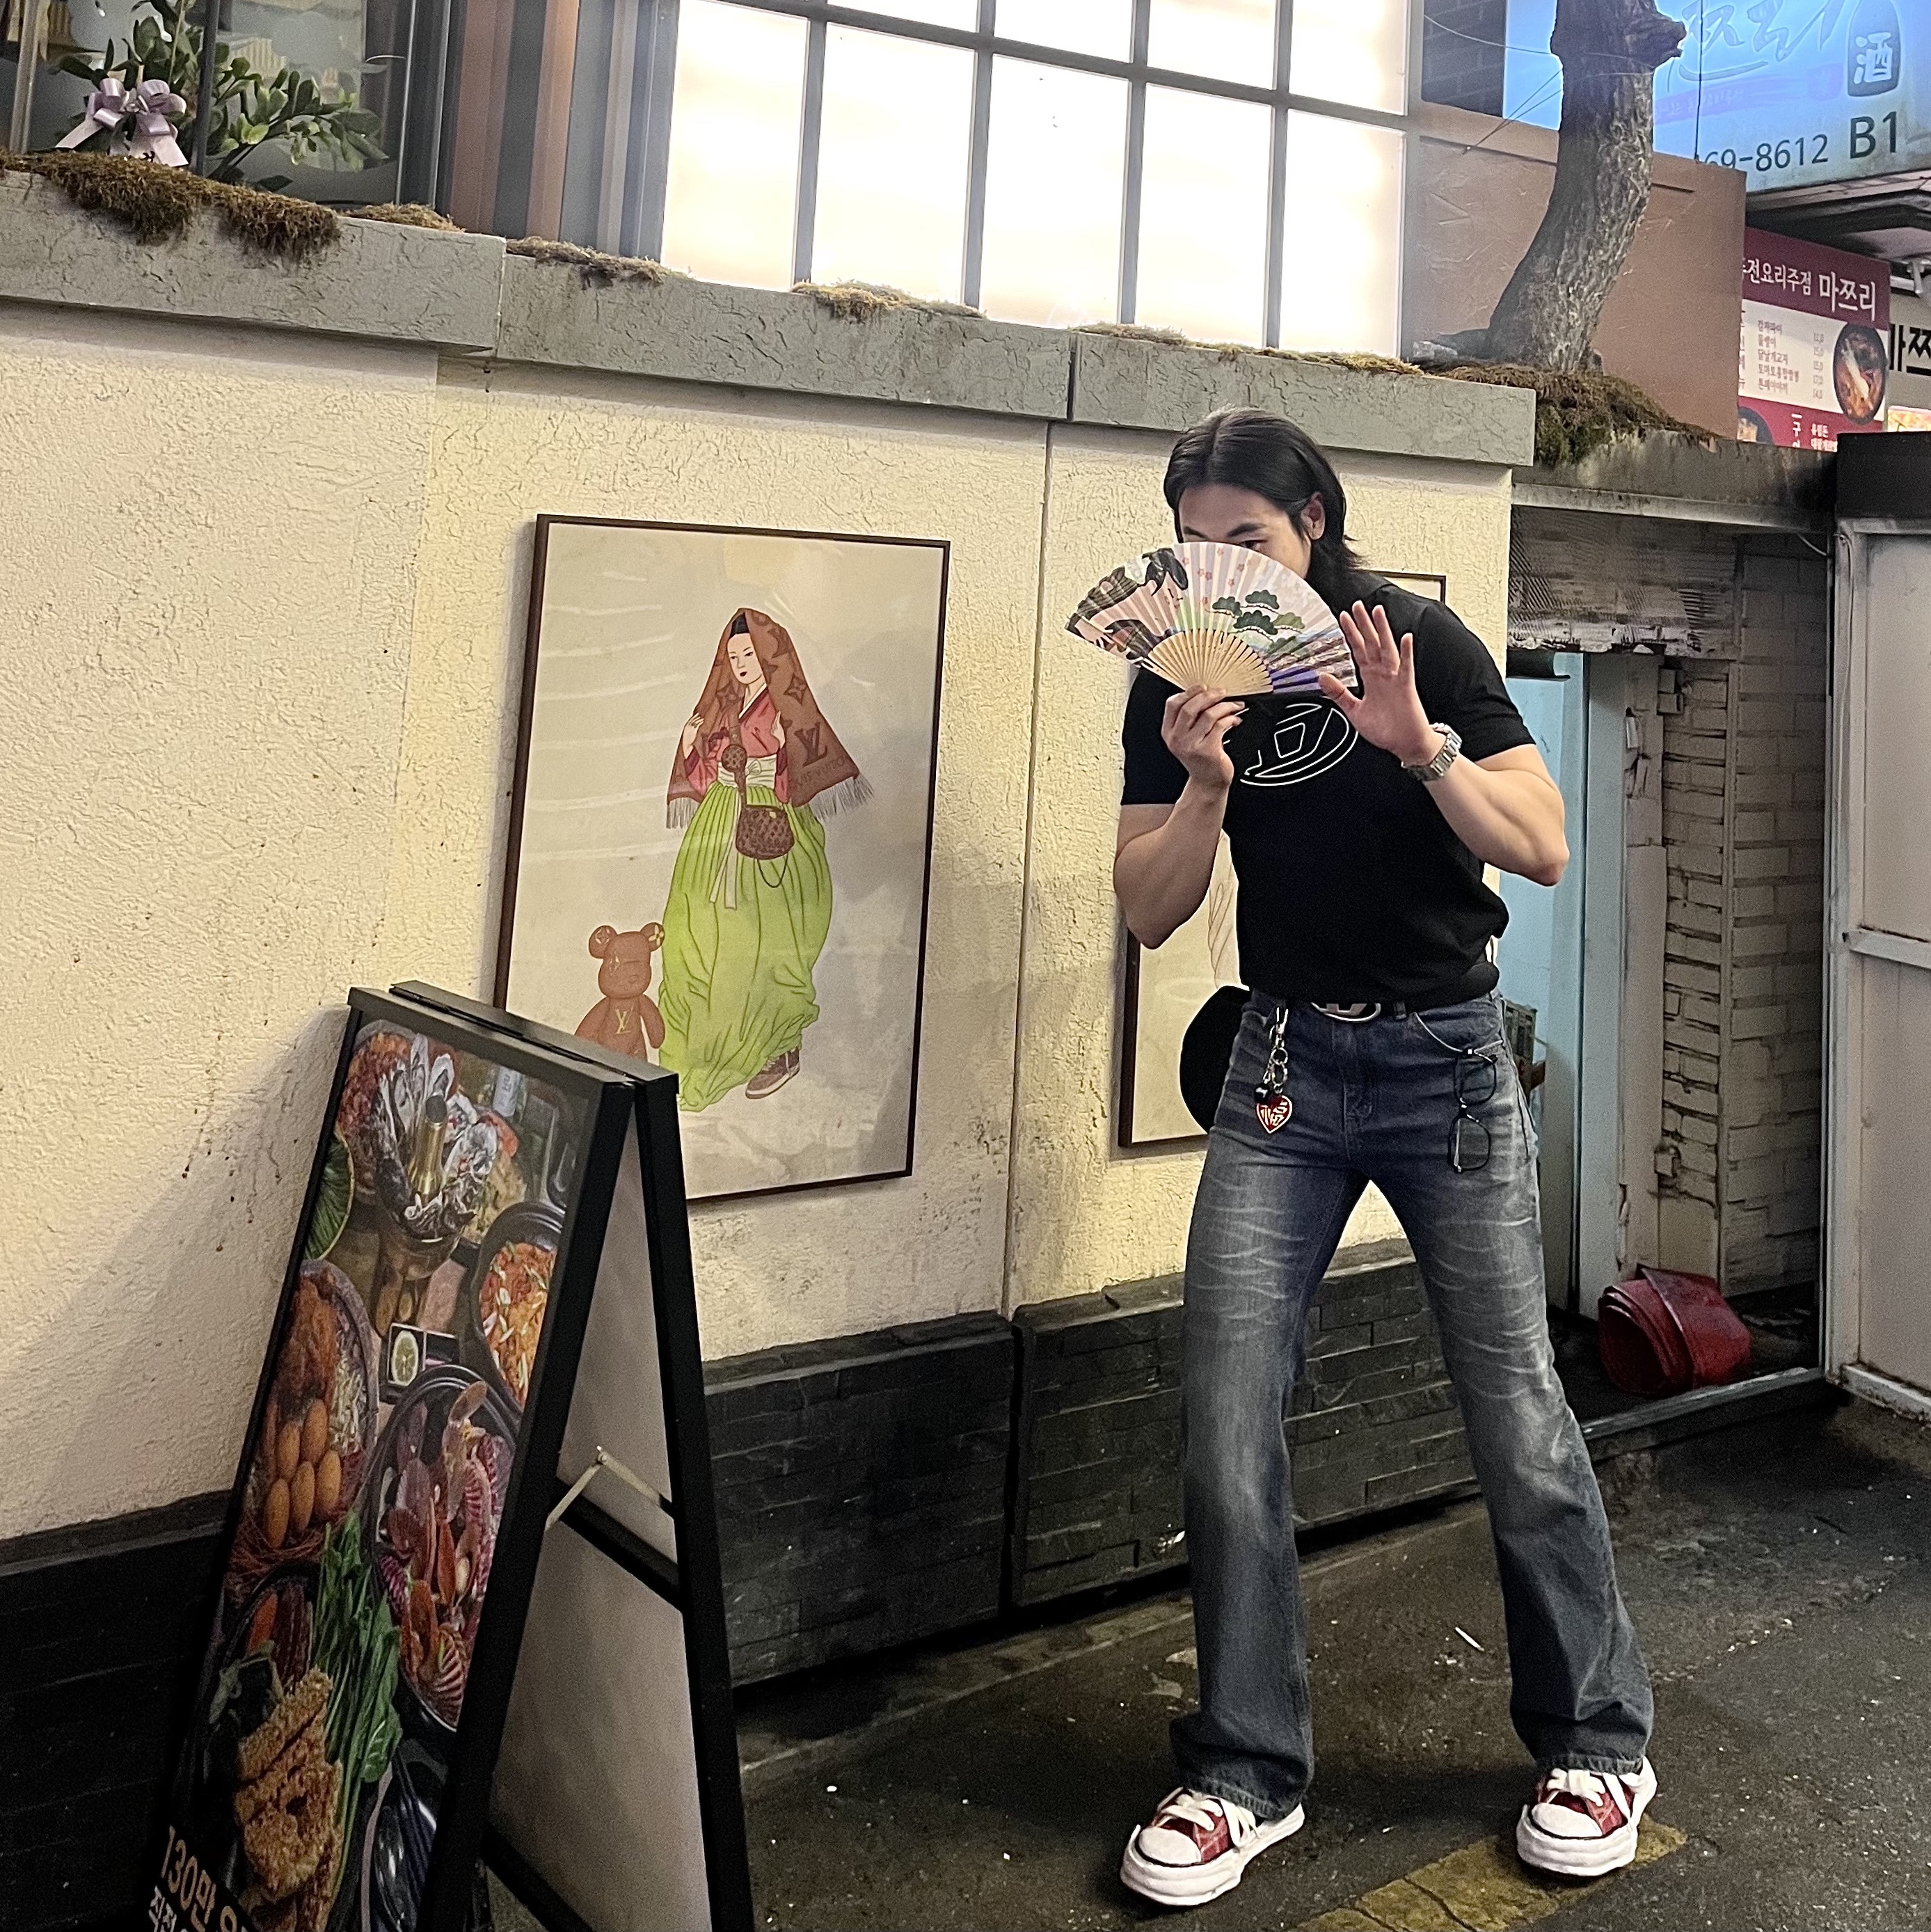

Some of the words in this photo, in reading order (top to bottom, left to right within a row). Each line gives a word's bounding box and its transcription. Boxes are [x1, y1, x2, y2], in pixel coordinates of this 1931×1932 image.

[1854, 32, 1893, 84] 酒
[1850, 111, 1898, 159] B1
[1742, 258, 1811, 296] 전요리주점
[1818, 271, 1876, 322] 마쯔리
